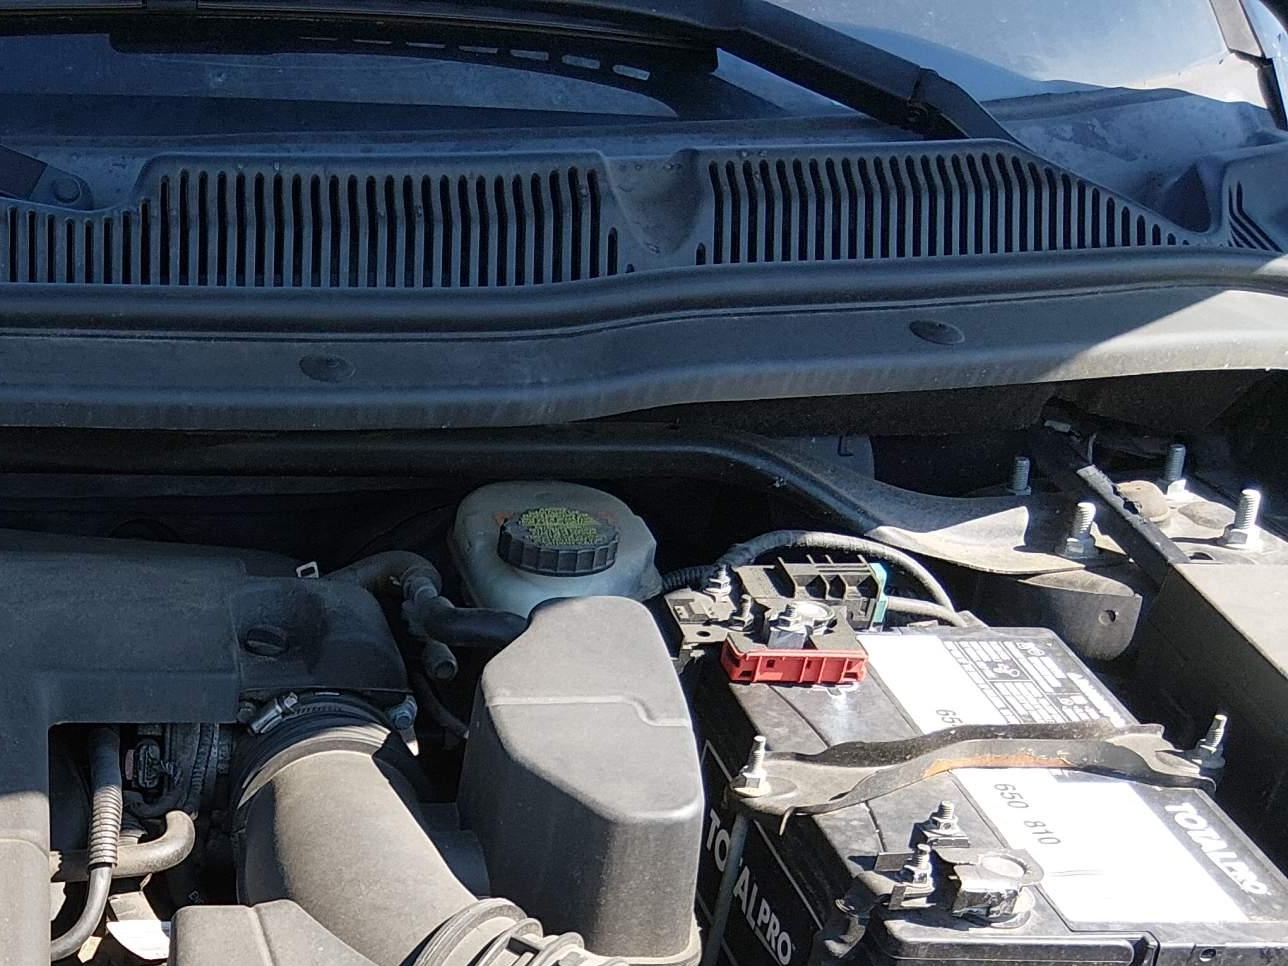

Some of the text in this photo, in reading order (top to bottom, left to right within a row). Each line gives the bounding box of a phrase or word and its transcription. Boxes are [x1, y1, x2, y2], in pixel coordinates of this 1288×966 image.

[994, 783, 1030, 809] 650
[1023, 820, 1061, 845] 810
[1165, 802, 1268, 896] TOTALPRO
[706, 808, 792, 966] TOALPRO
